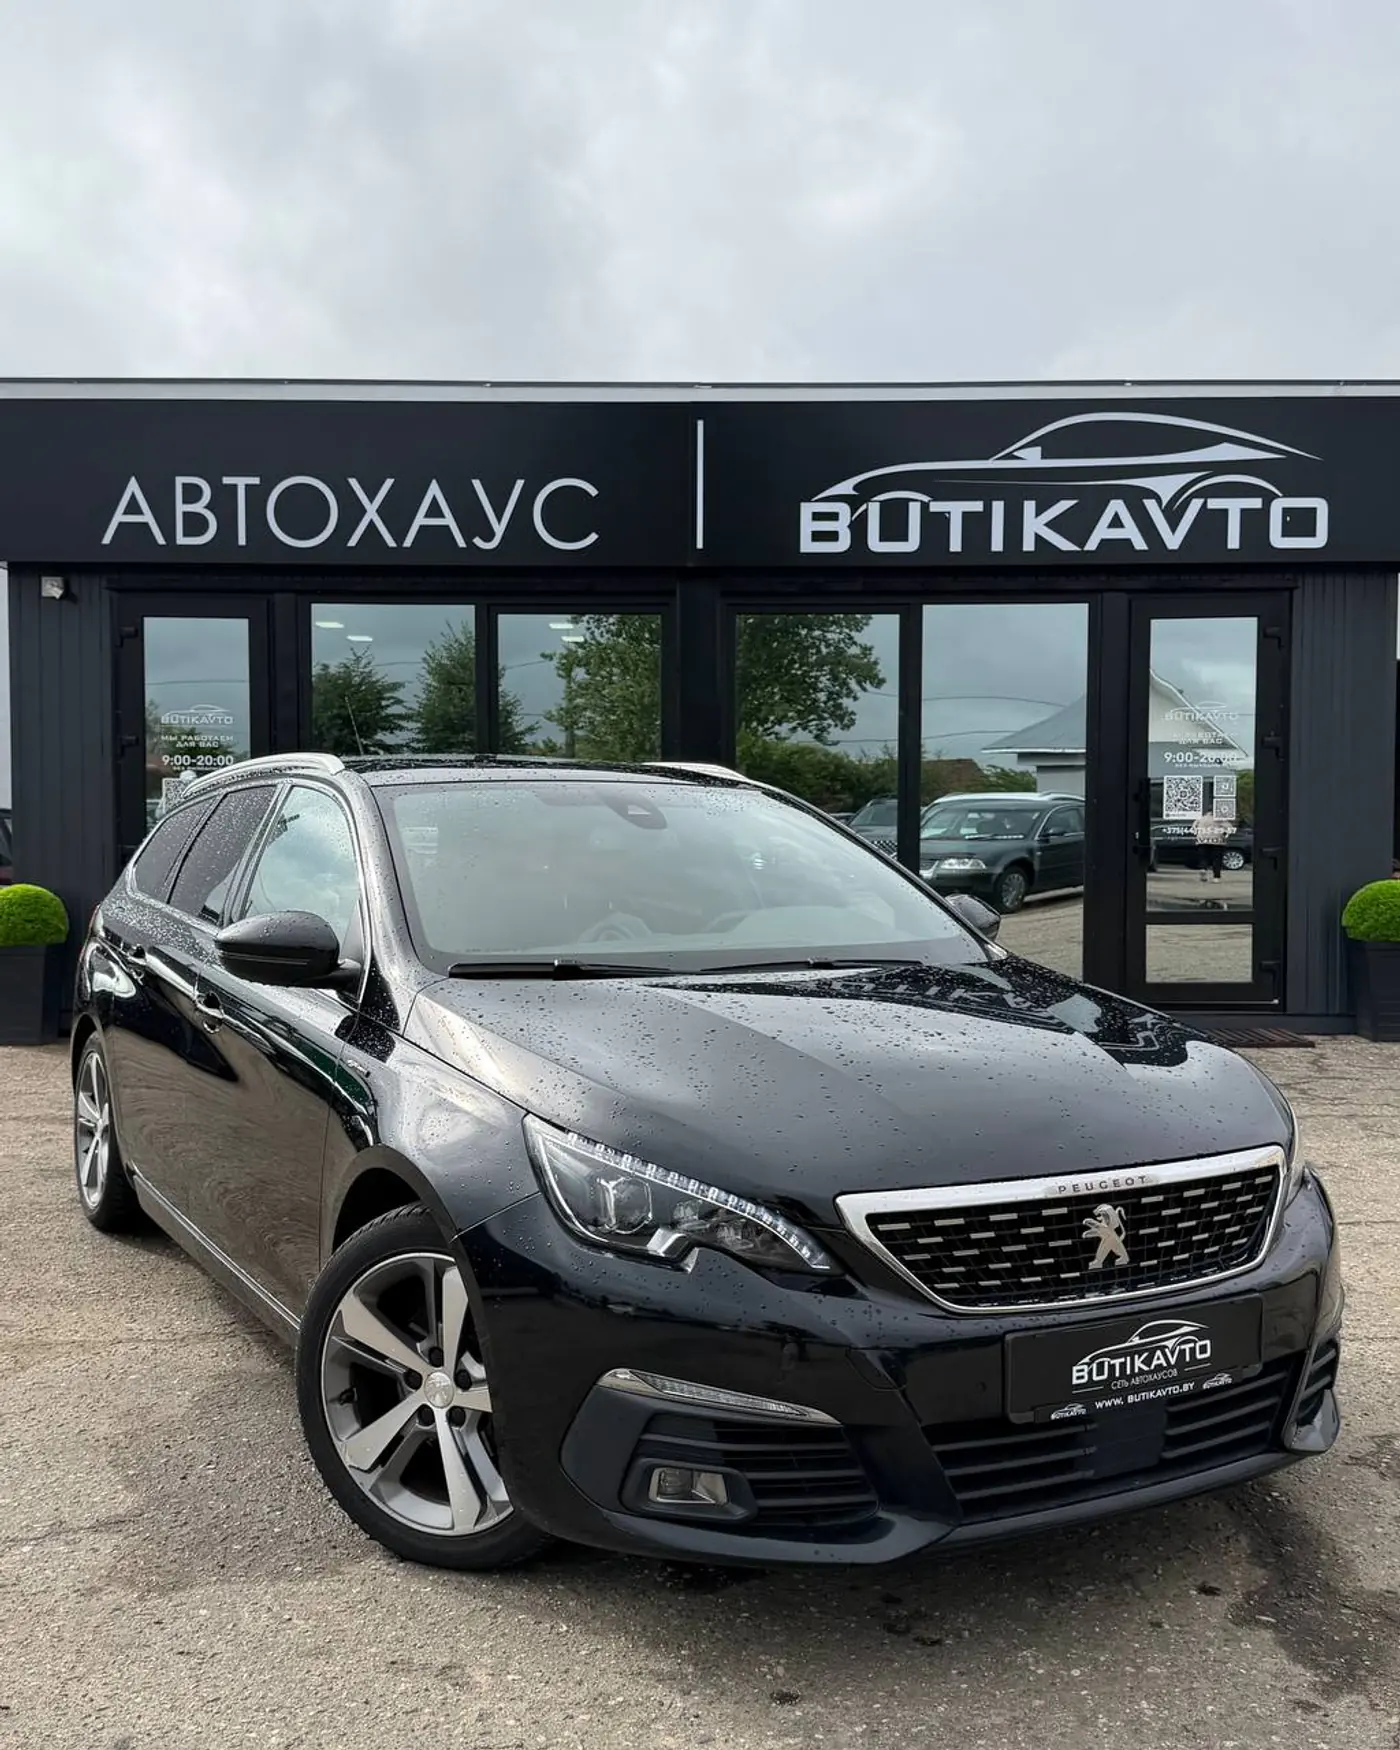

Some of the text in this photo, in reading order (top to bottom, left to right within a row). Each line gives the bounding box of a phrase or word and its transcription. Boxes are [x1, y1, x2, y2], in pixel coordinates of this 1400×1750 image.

[101, 475, 599, 550] АВТОХАУС
[800, 497, 1328, 554] BUTIKAVTO
[161, 715, 234, 724] BUTIKAVTO
[162, 755, 234, 766] 9:00-20:00
[1057, 1175, 1146, 1195] PEUGEOT
[1072, 1339, 1212, 1385] BUTIKAVTO
[1110, 1368, 1178, 1390] СЕТЬ АВТОХАУСОВ
[1095, 1382, 1195, 1410] WWW. BUTIKAVTO.BY
